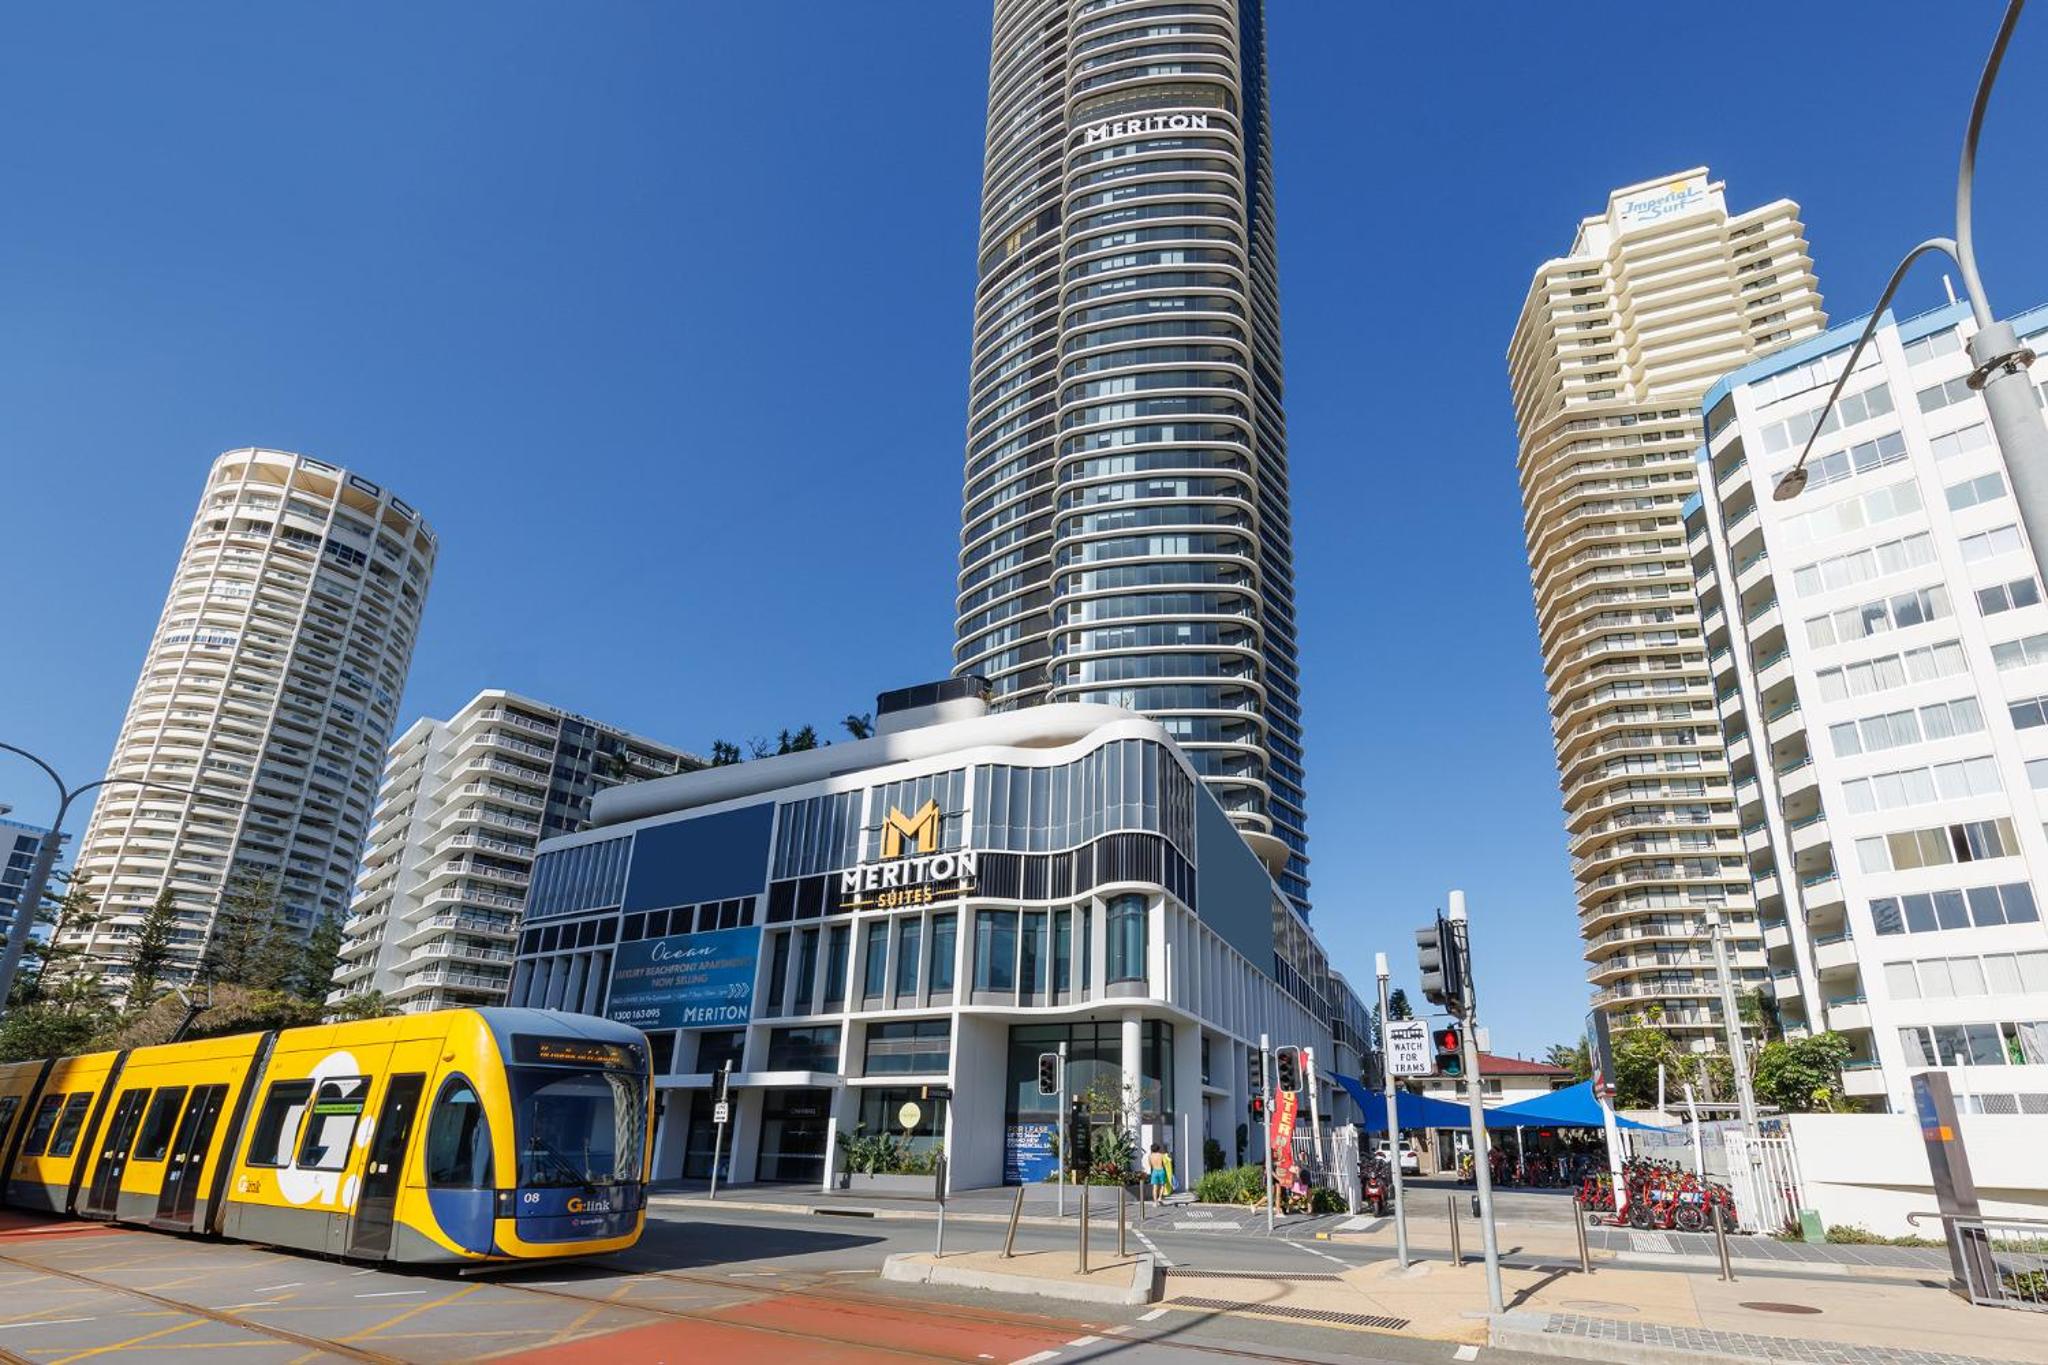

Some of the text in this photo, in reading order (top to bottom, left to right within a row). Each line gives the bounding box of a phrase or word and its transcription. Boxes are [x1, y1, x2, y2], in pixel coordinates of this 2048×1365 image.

[1085, 114, 1208, 145] MERITON
[1621, 187, 1703, 214] Imperial
[1638, 198, 1703, 221] Surf
[841, 851, 978, 894] MERITON
[878, 887, 933, 908] SUITES
[651, 941, 718, 962] Ocean
[652, 974, 709, 988] NOW SELLING
[682, 1005, 748, 1023] MERITON
[1394, 1042, 1422, 1051] WATCH
[1400, 1053, 1418, 1061] FOR
[1395, 1063, 1425, 1072] TRAMS
[523, 1192, 540, 1203] 08
